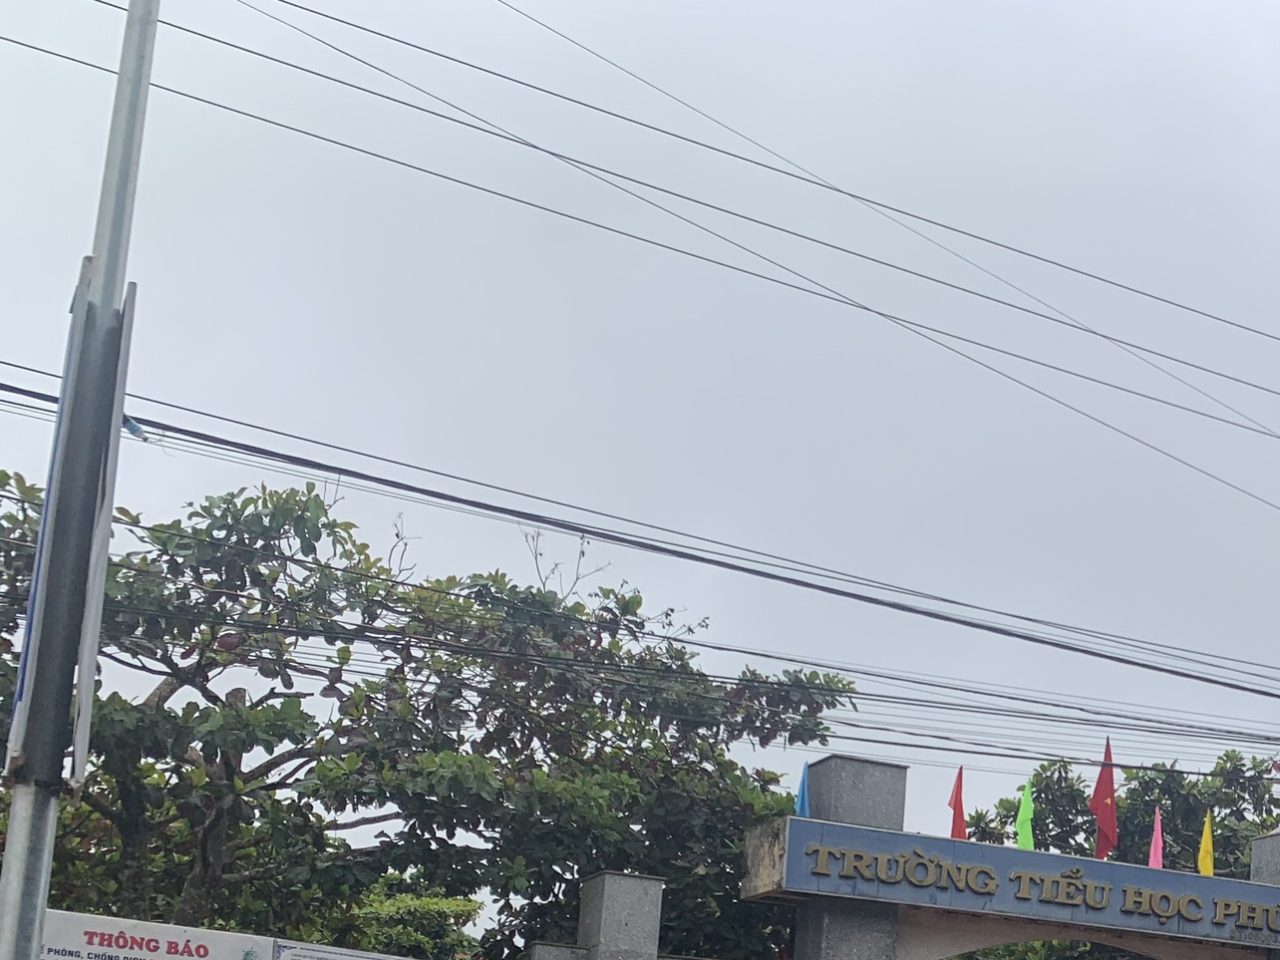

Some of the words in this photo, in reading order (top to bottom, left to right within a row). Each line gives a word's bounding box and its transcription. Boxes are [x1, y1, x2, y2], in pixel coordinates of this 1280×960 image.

[804, 843, 998, 895] TRƯỜNG
[1008, 866, 1114, 910] TIỂU
[1121, 885, 1205, 926] HỌC
[84, 931, 160, 953] THÔNG
[166, 939, 209, 958] BÁO
